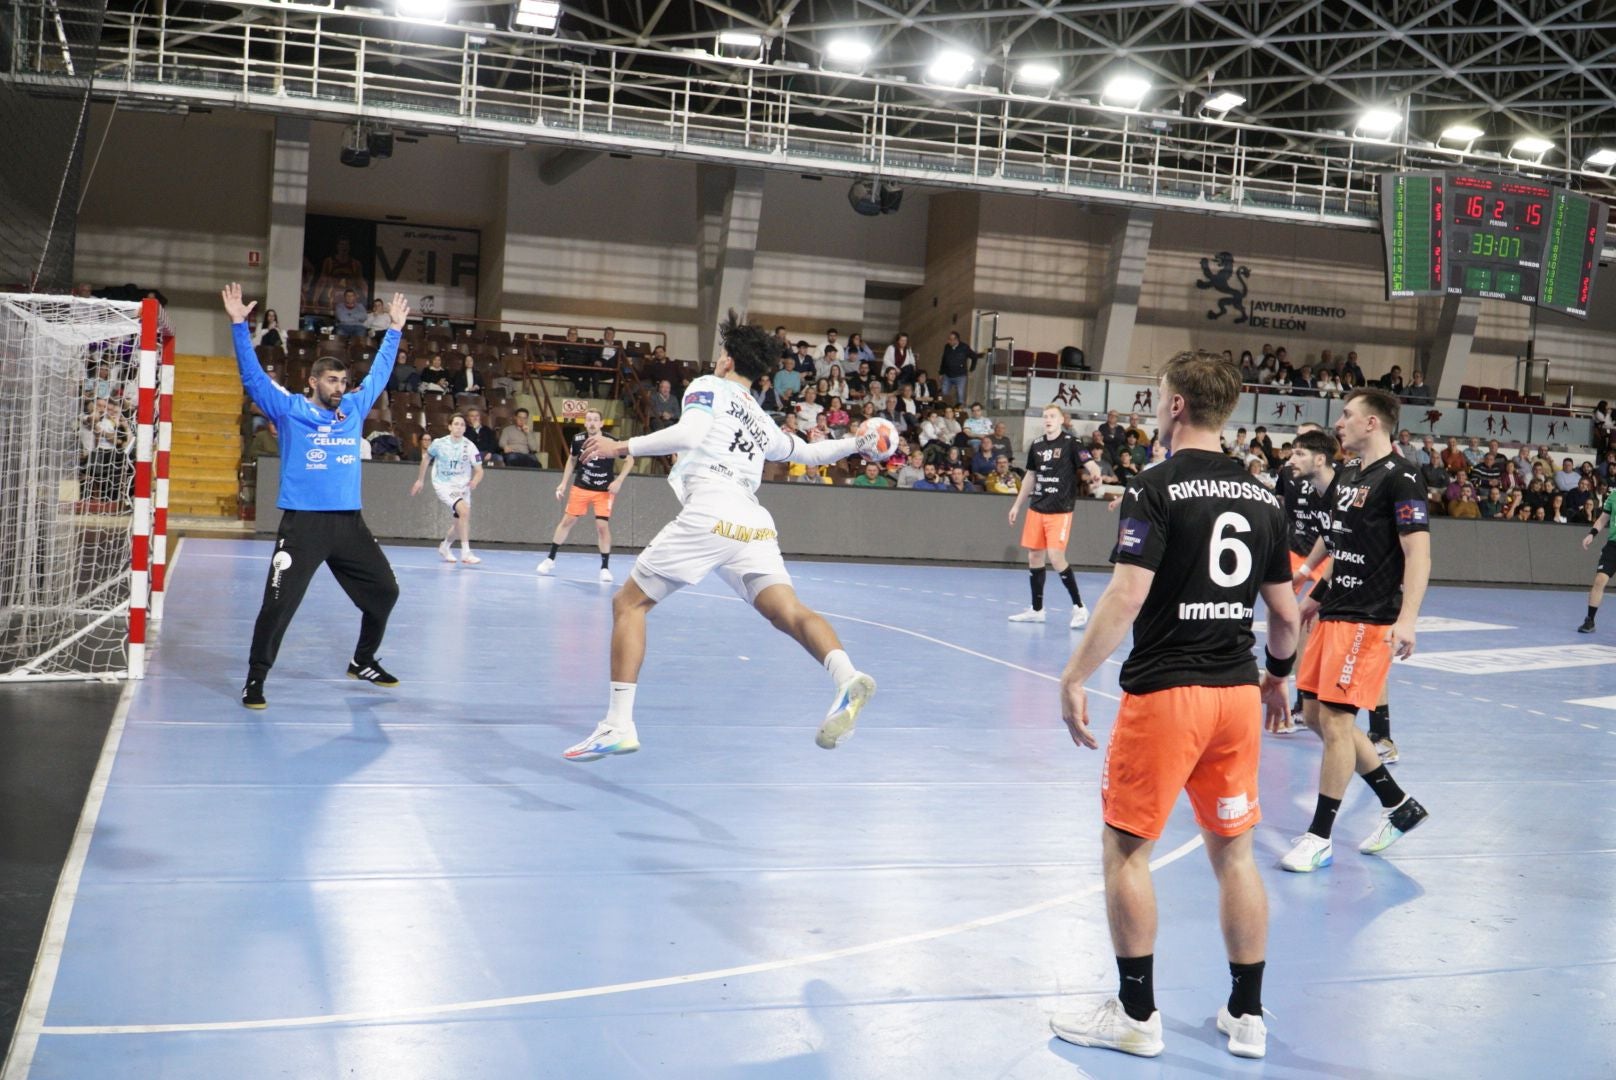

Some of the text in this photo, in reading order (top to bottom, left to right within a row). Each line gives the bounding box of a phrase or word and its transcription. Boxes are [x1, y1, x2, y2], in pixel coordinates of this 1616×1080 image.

[1466, 195, 1484, 218] 16
[1494, 200, 1505, 219] 2
[1526, 204, 1542, 226] 15
[1472, 233, 1521, 258] 33:07
[1254, 302, 1346, 319] AYUNTAMIENTO
[1252, 315, 1307, 331] DE LEÓN
[313, 437, 357, 446] CELLPACK
[1209, 511, 1253, 588] 6
[1335, 575, 1364, 589] +GF+
[1340, 654, 1357, 685] BBC
